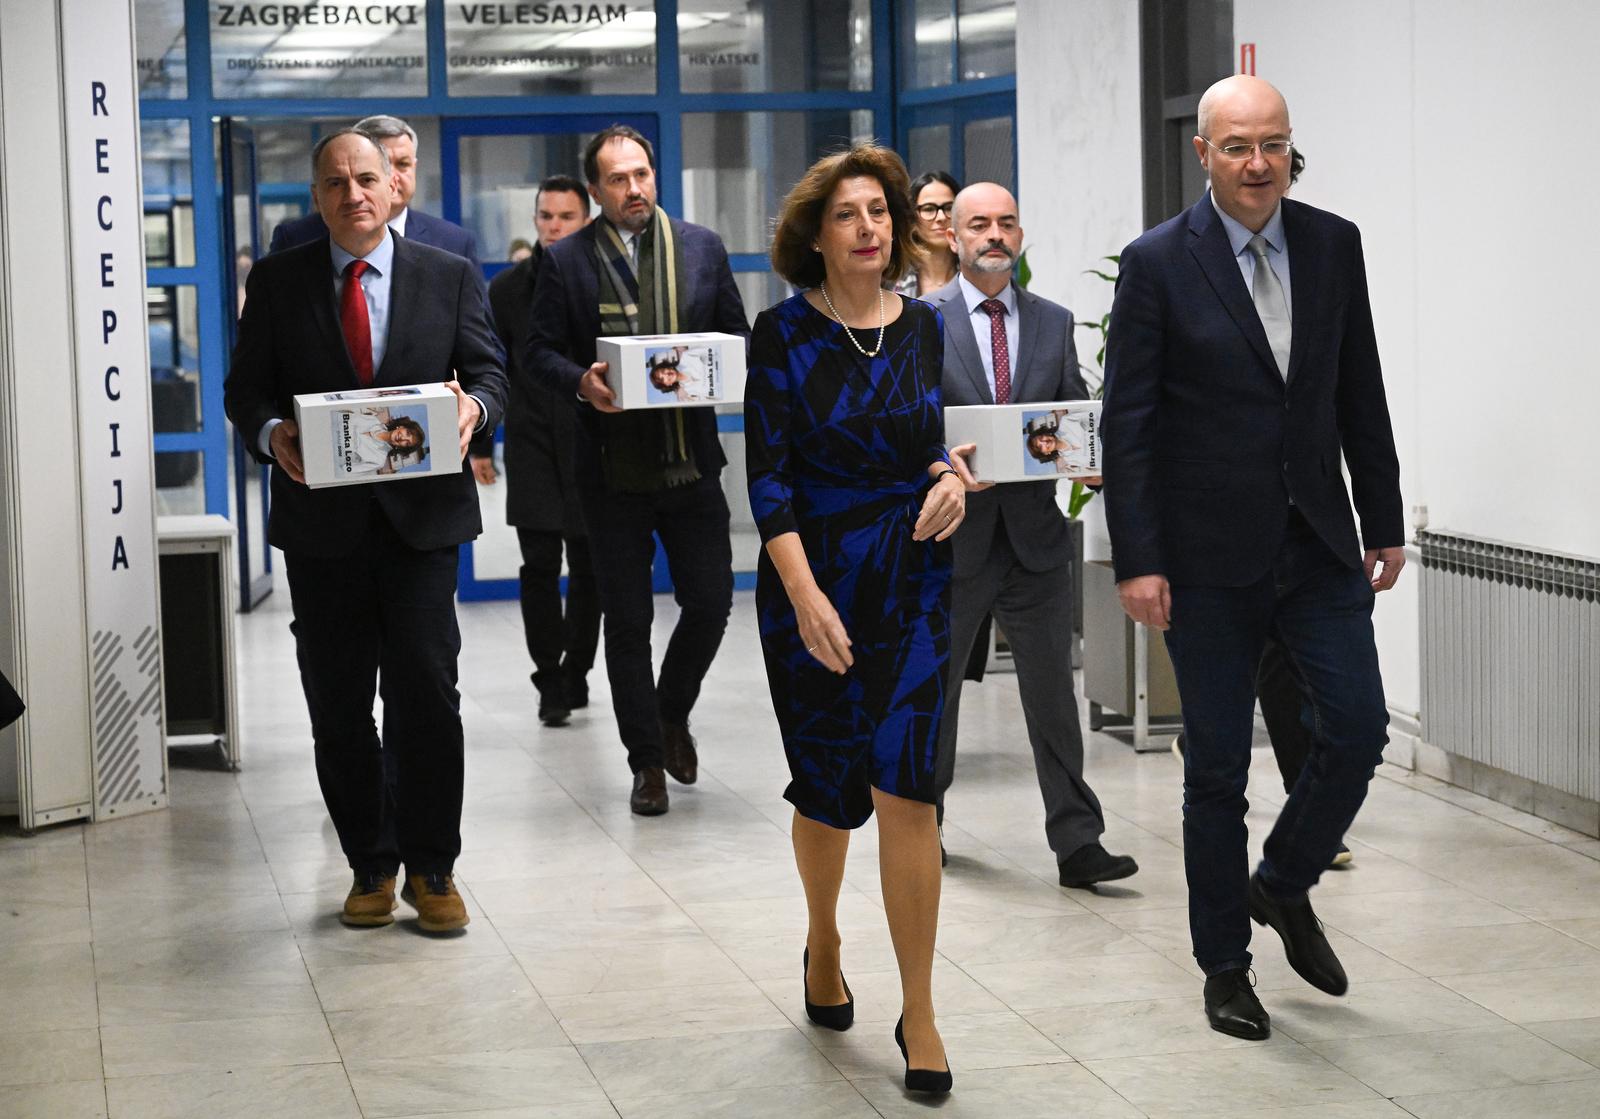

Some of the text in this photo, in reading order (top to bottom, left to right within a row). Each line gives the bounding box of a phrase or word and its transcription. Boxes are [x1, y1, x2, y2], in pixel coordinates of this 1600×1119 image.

[460, 4, 627, 24] VELESAJAM
[316, 56, 424, 69] KOMUNIKACIJE
[450, 55, 497, 68] GRADA
[689, 52, 760, 66] HRVATSKE
[91, 80, 129, 571] RECEPCIJA
[343, 414, 352, 473] Branka Lozo
